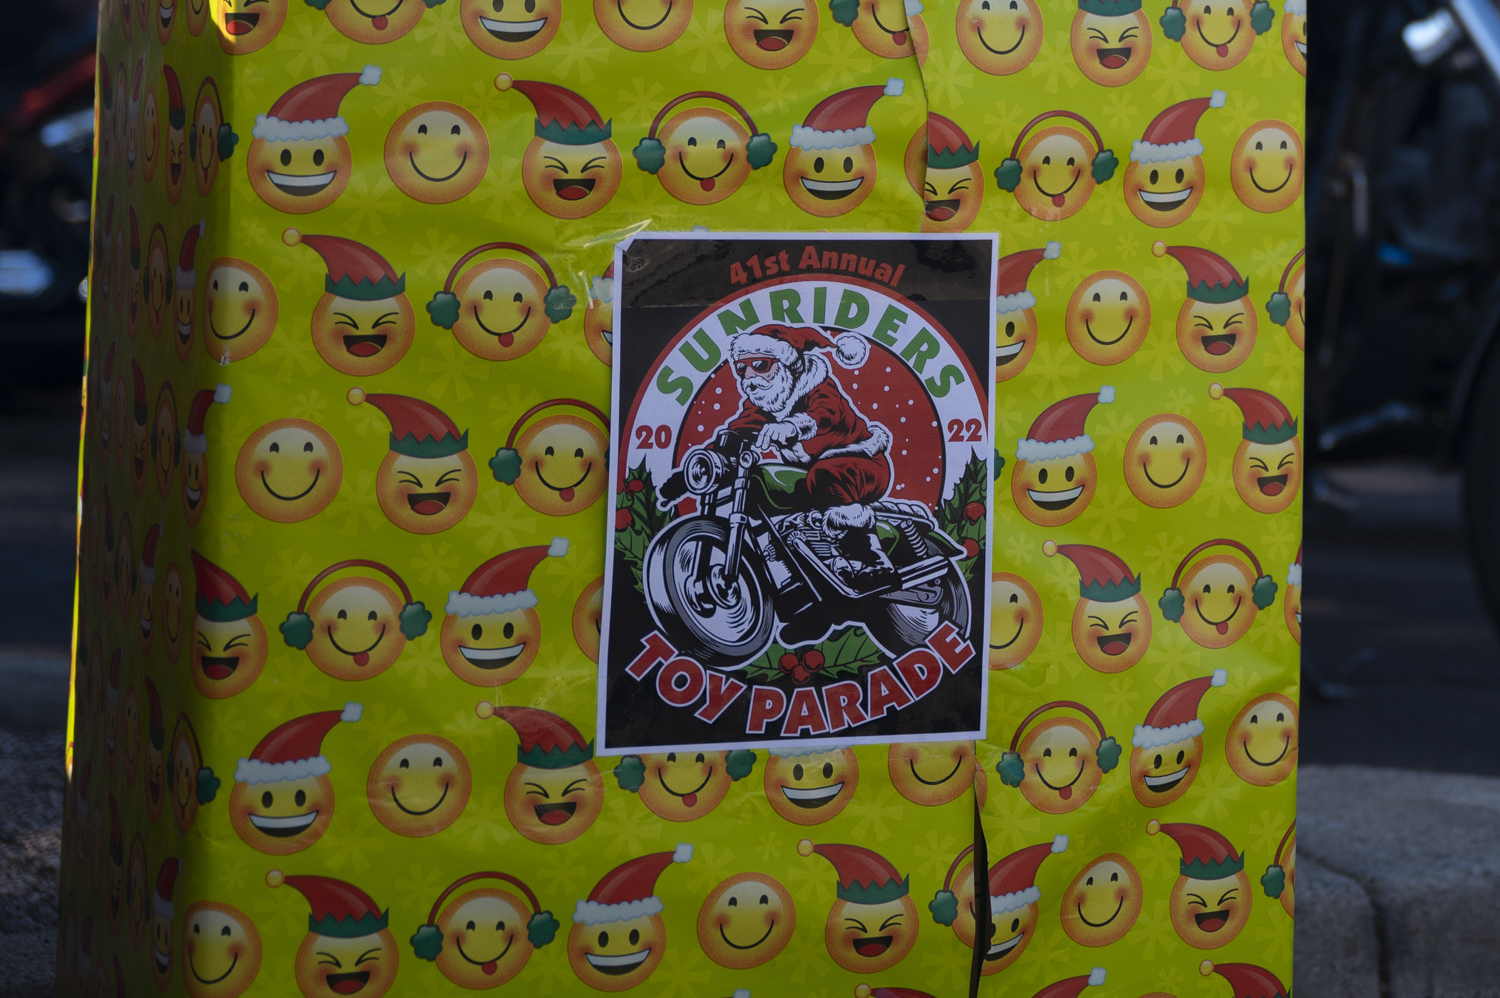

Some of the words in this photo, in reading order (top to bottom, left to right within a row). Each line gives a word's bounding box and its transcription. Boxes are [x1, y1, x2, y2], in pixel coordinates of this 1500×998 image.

[729, 249, 790, 286] 41st
[798, 245, 906, 288] Annual
[656, 286, 966, 406] SUNRIDERS
[634, 423, 673, 450] 20
[946, 418, 983, 444] 22
[626, 630, 749, 724] TOY
[745, 620, 976, 737] PARADE
